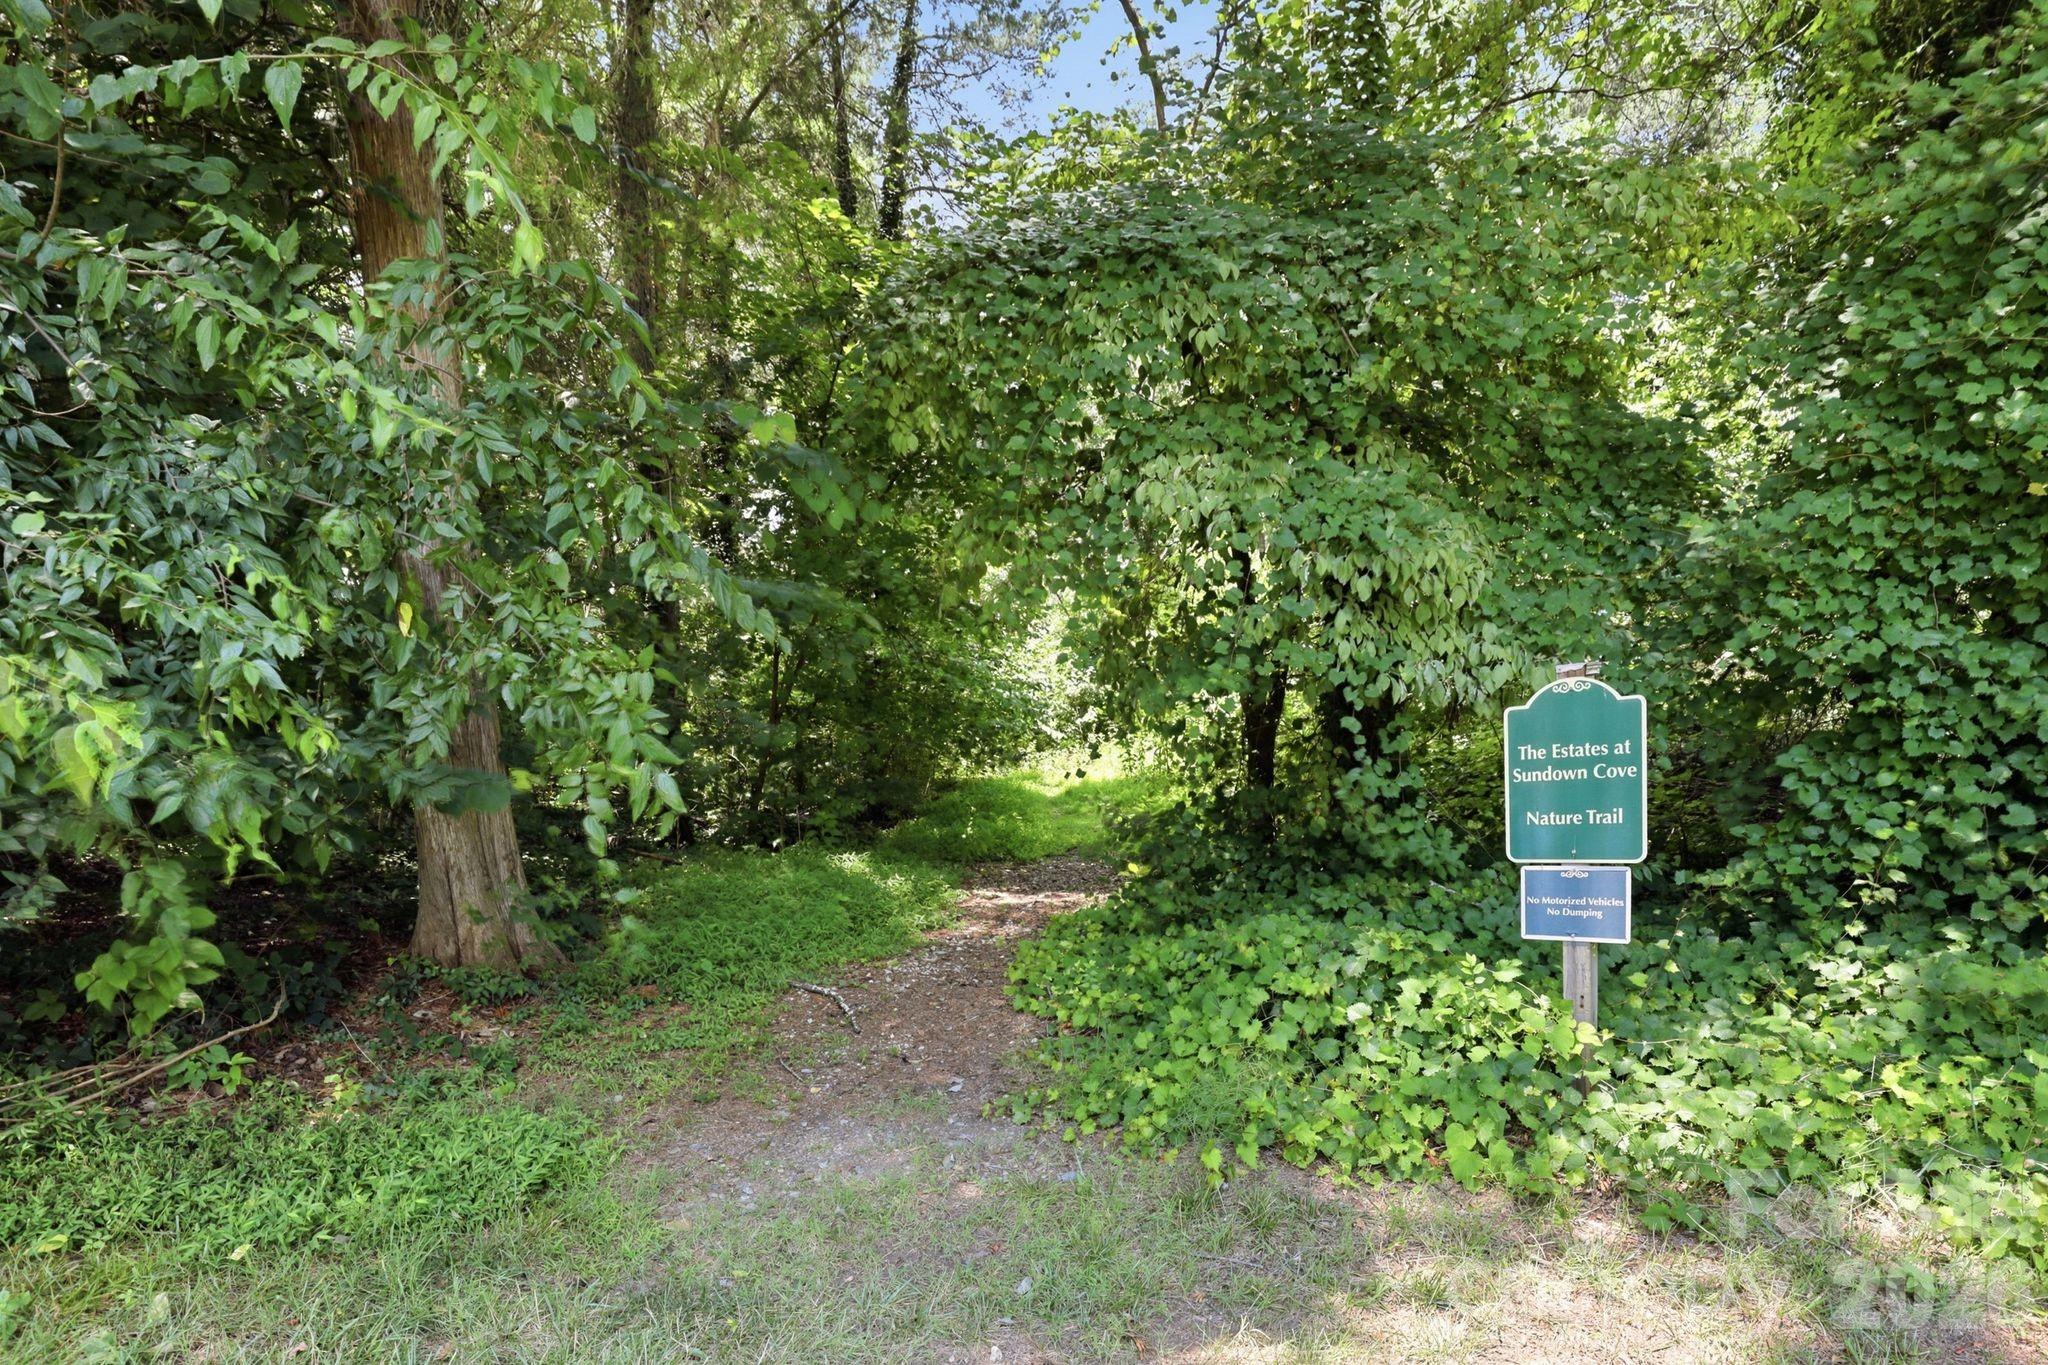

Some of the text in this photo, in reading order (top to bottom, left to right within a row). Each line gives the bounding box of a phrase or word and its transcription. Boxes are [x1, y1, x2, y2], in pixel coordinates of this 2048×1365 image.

[1518, 739, 1631, 761] The Estates at
[1512, 763, 1638, 783] Sundown Cove
[1526, 808, 1623, 826] Nature Trail
[1526, 896, 1625, 907] No Motorized Vehicles
[1546, 907, 1604, 919] No Dumping
